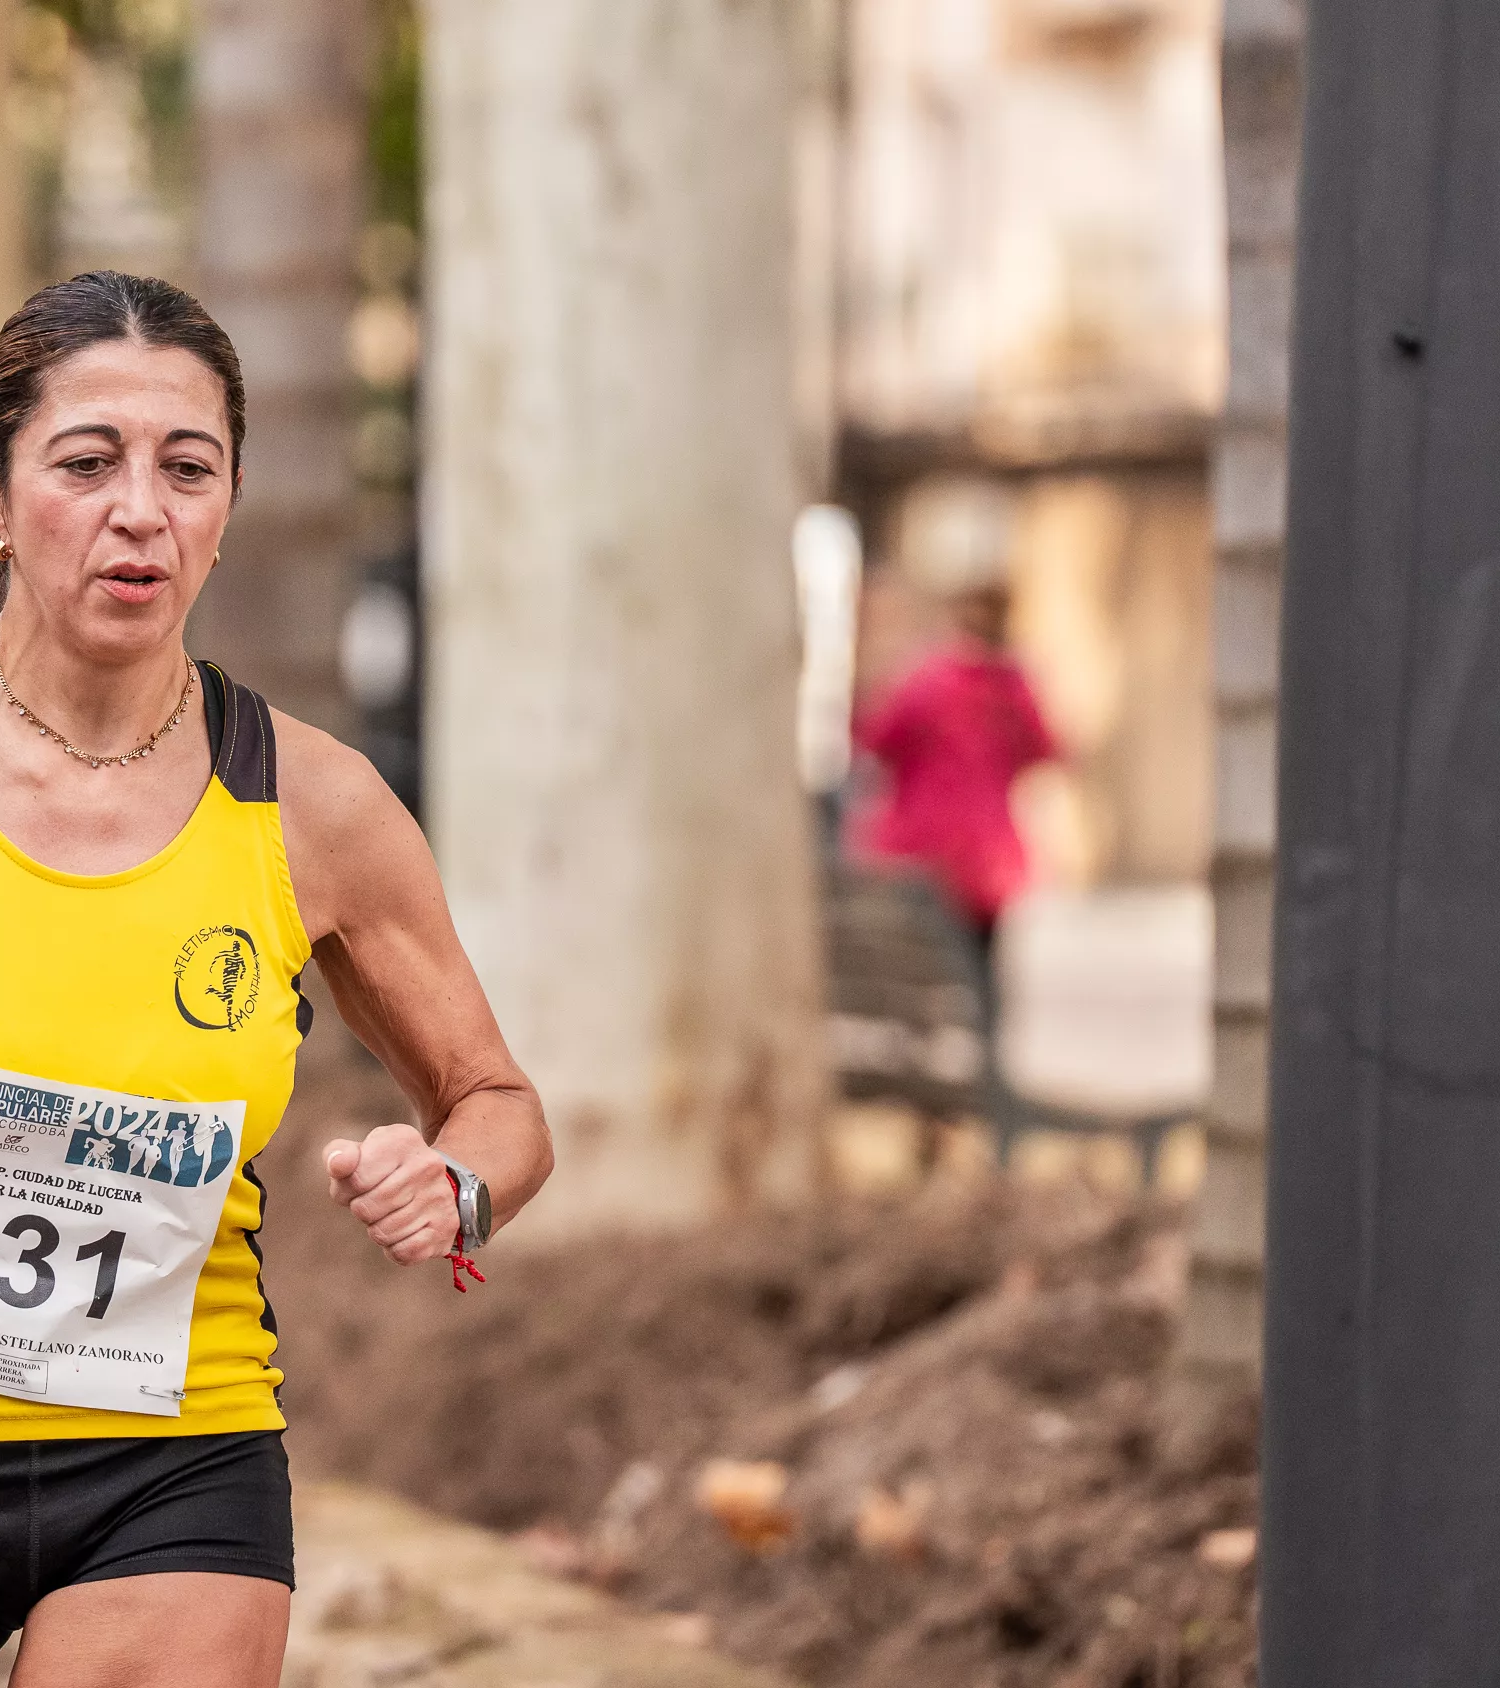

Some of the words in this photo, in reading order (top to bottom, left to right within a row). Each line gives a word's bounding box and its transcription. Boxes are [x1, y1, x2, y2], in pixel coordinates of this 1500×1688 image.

[53, 1096, 74, 1113] DE
[71, 1100, 170, 1143] 2024
[12, 1169, 65, 1188] CIUDAD
[67, 1180, 86, 1193] DE
[88, 1184, 143, 1203] LUCENA
[8, 1186, 28, 1200] LA
[30, 1191, 103, 1216] IGUALDAD
[78, 1344, 164, 1365] ZAMORANO
[0, 1373, 26, 1385] HORAS
